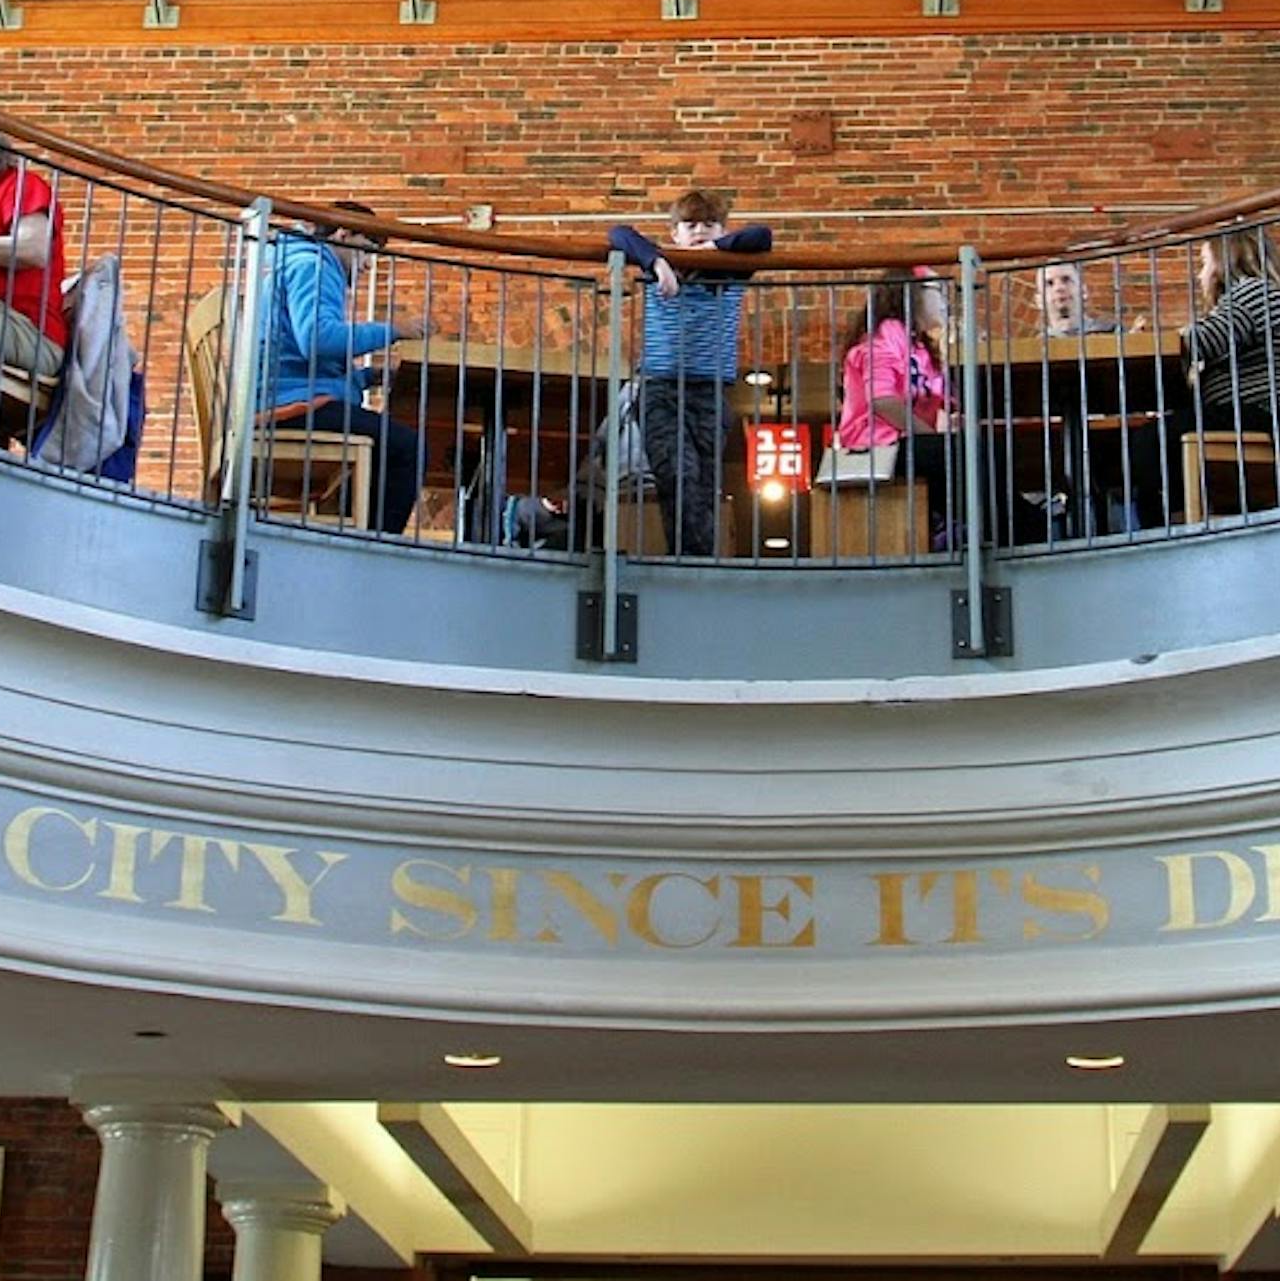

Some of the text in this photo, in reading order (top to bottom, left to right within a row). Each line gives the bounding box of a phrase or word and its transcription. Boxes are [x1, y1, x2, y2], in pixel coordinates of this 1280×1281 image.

[3, 806, 350, 926] CITY
[389, 859, 816, 949] SINCE
[867, 863, 1110, 946] ITS
